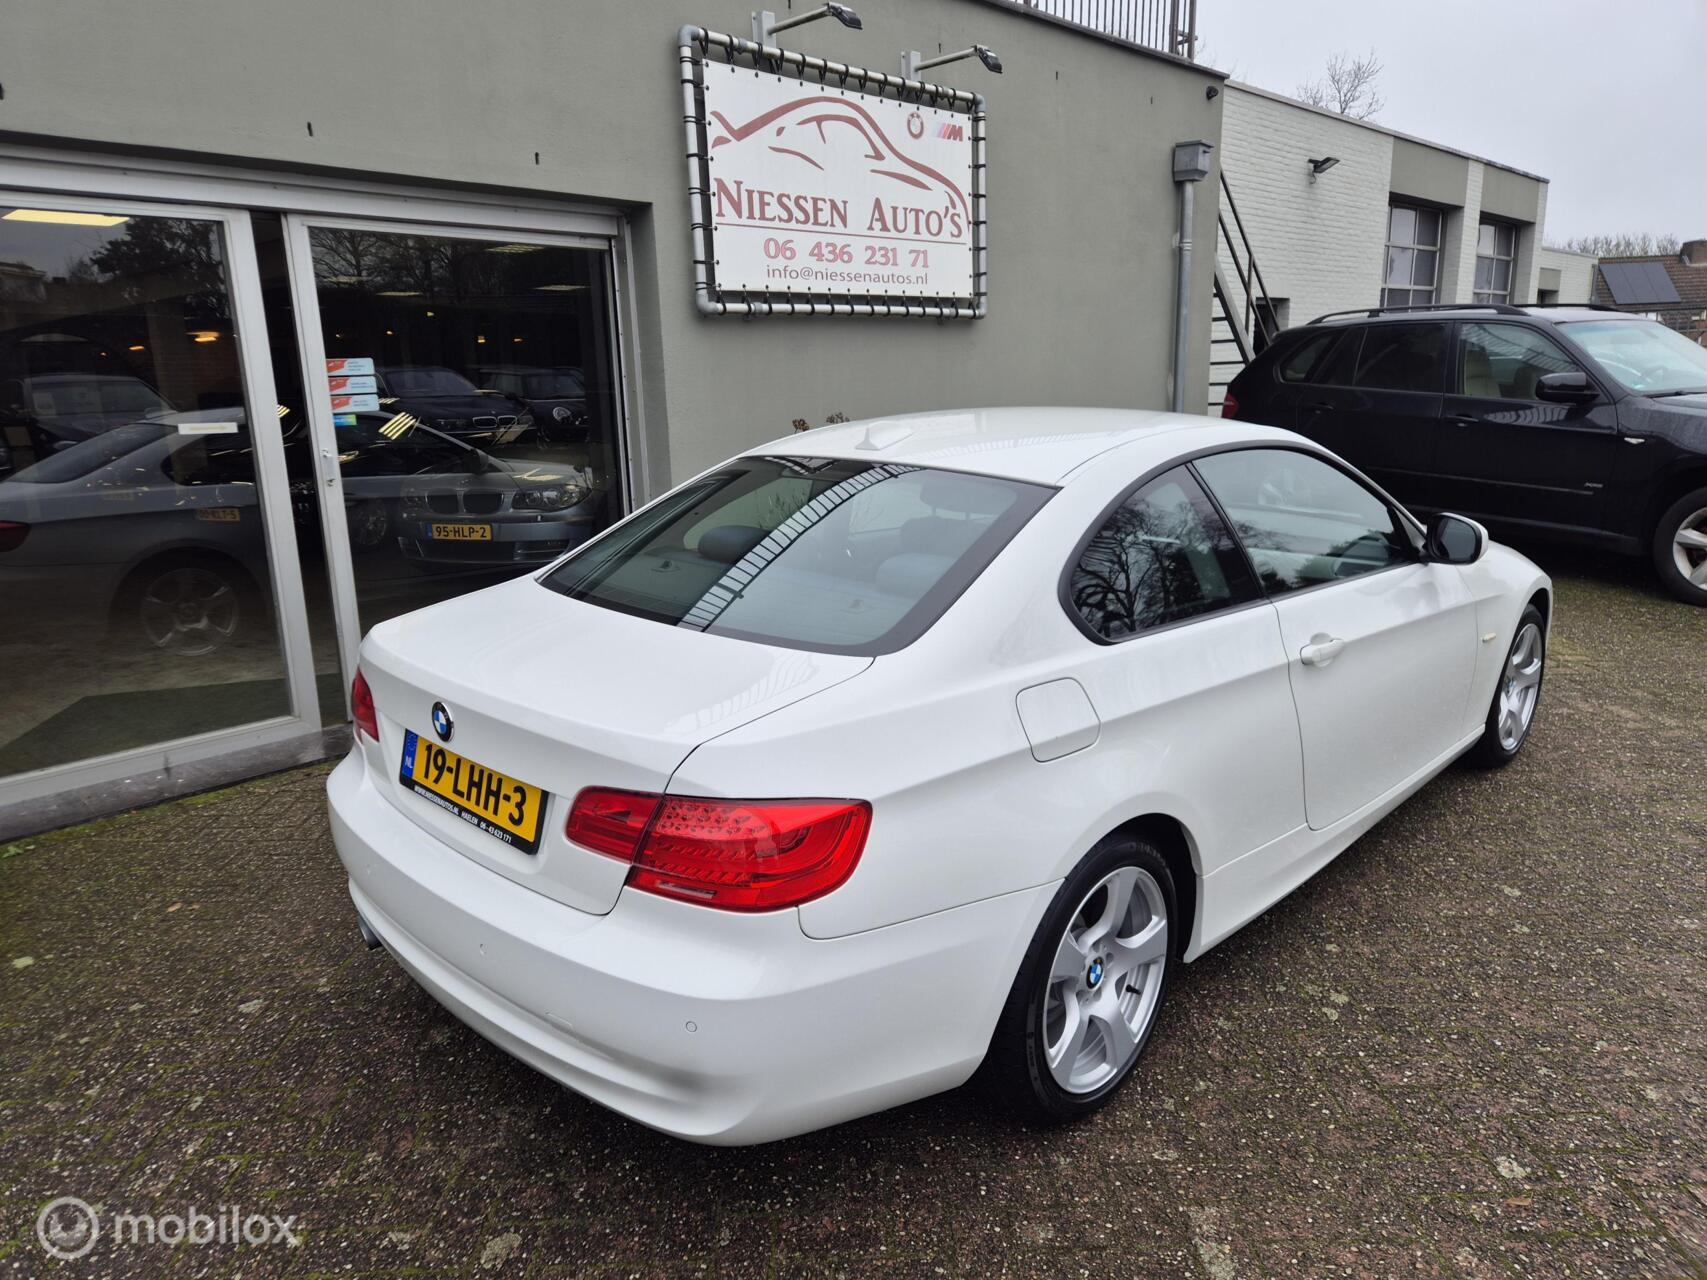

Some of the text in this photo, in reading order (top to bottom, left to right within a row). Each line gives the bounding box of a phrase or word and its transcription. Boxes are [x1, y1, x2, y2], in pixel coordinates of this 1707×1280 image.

[713, 177, 963, 239] NIESSEN AUTO'S
[763, 237, 930, 268] 06 436 231 71
[766, 264, 929, 286] info@niessenautos.nl
[434, 525, 488, 540] 95-HLP-2
[405, 755, 414, 769] NL
[423, 743, 527, 827] 19-LHH-3
